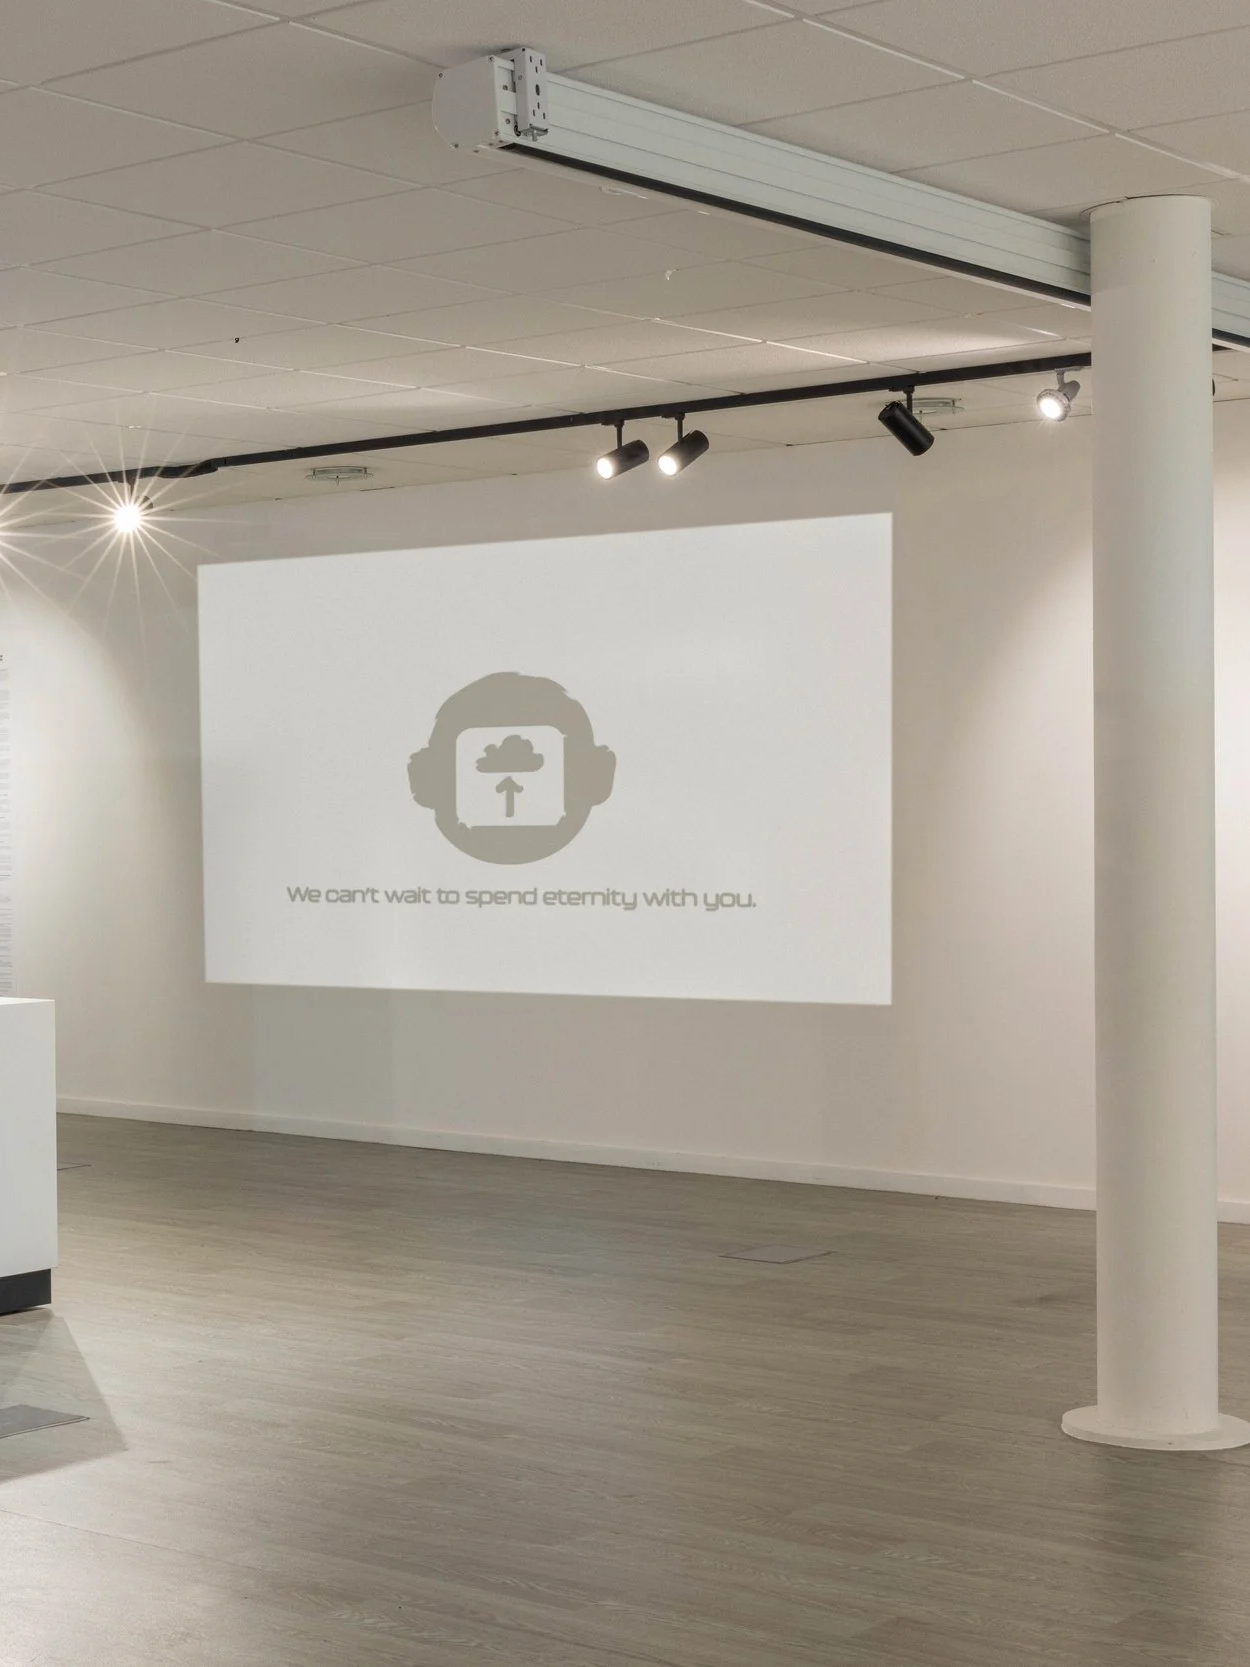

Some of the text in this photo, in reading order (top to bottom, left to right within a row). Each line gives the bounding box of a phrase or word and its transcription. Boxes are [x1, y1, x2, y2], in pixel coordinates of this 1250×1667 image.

[287, 886, 757, 912] We can't wait to spend eternity with you.
